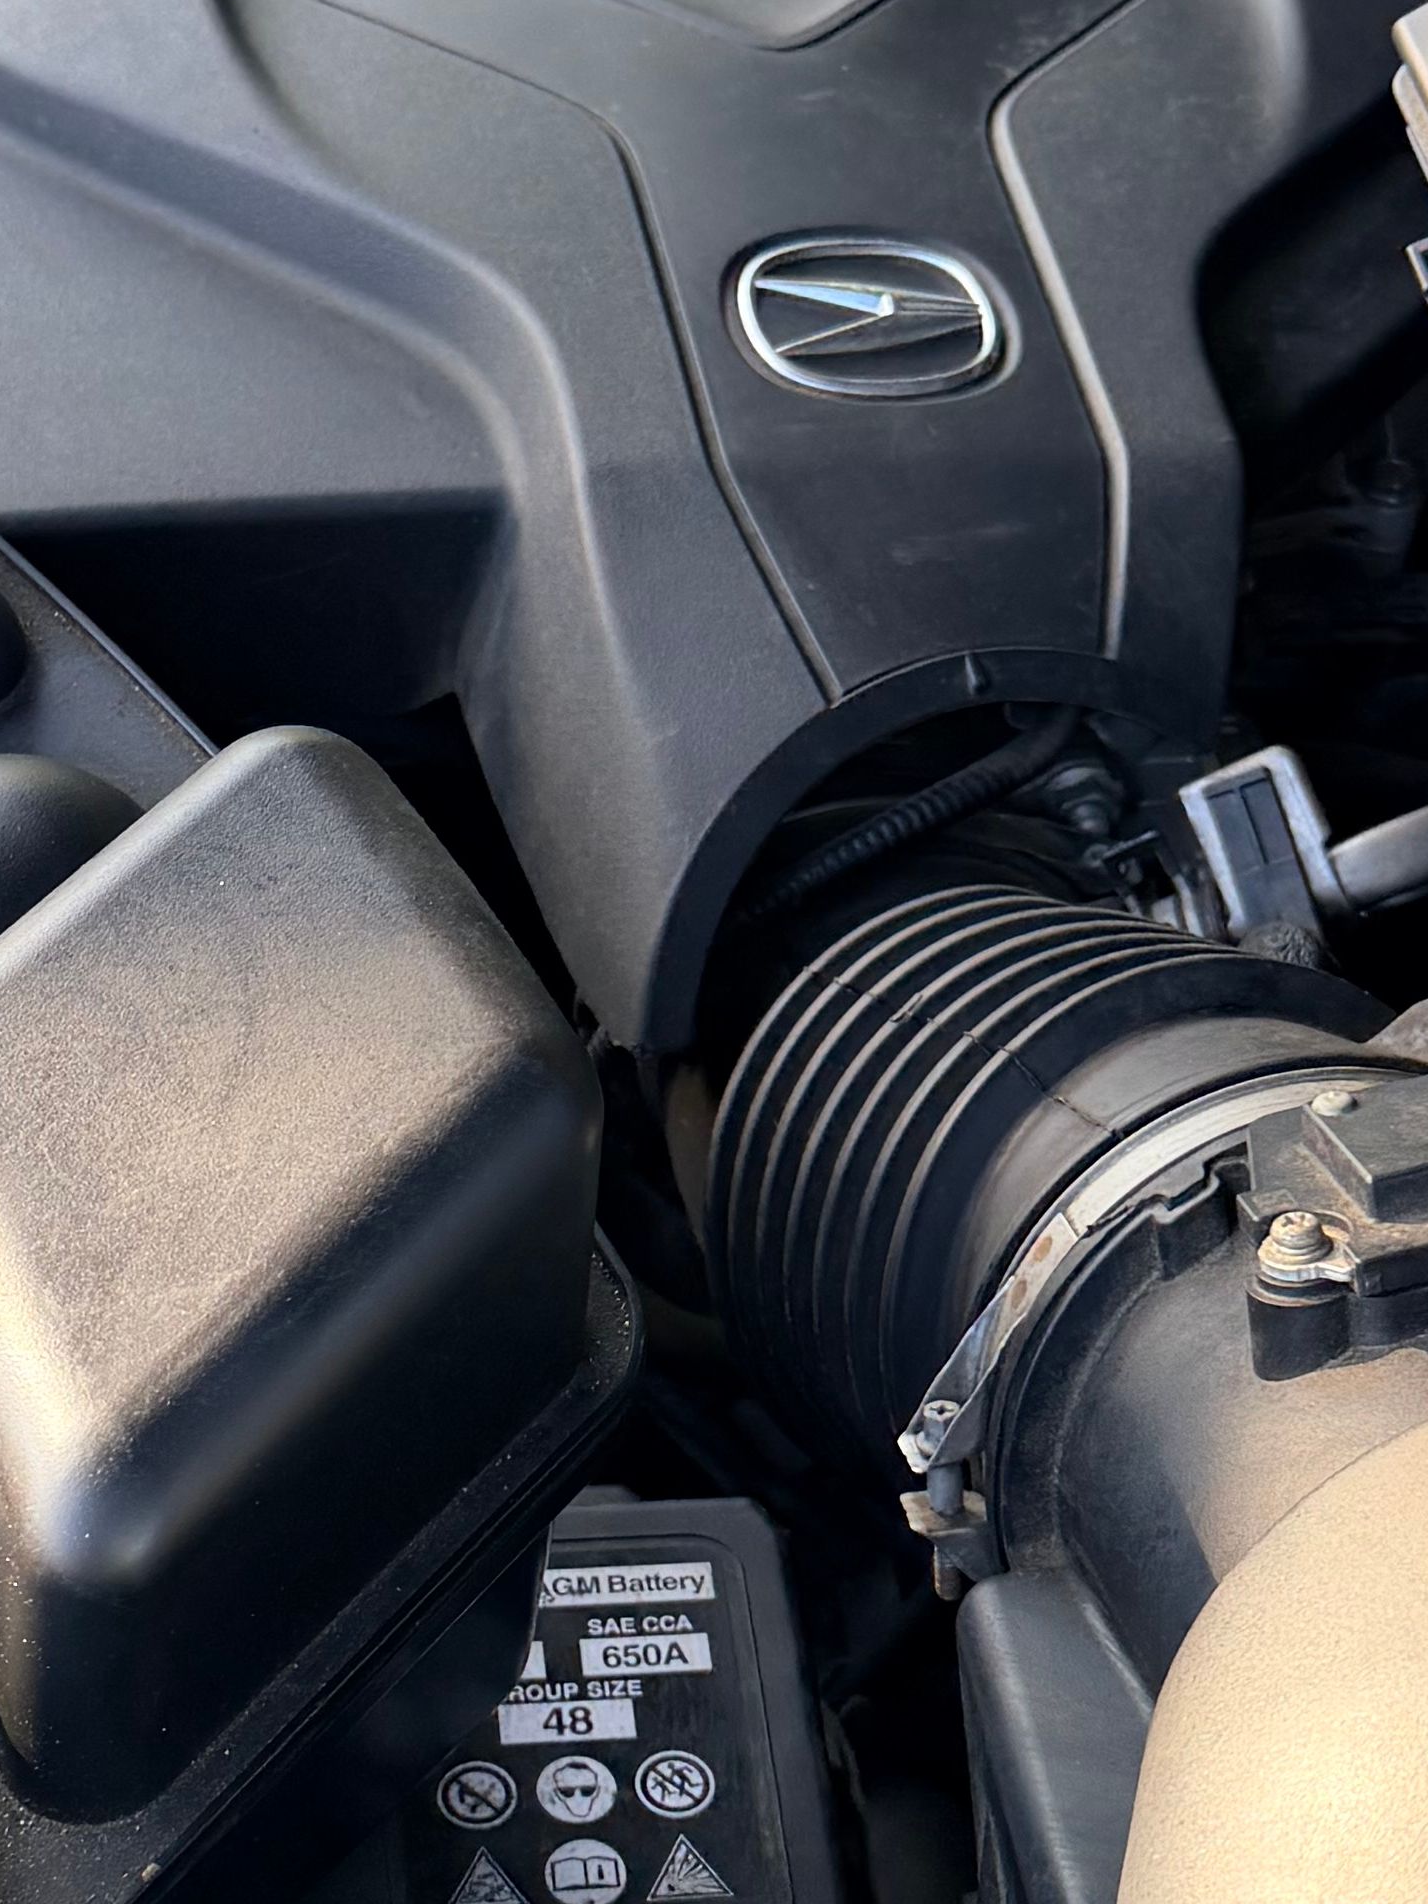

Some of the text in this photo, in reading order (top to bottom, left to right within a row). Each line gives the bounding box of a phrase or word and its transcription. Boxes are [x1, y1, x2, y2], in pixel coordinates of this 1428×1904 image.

[608, 1574, 705, 1594] Battery
[587, 1614, 693, 1635] SAE CCA
[602, 1642, 689, 1668] 650A
[509, 1679, 643, 1701] ROUP SIZE
[543, 1706, 594, 1736] 48
